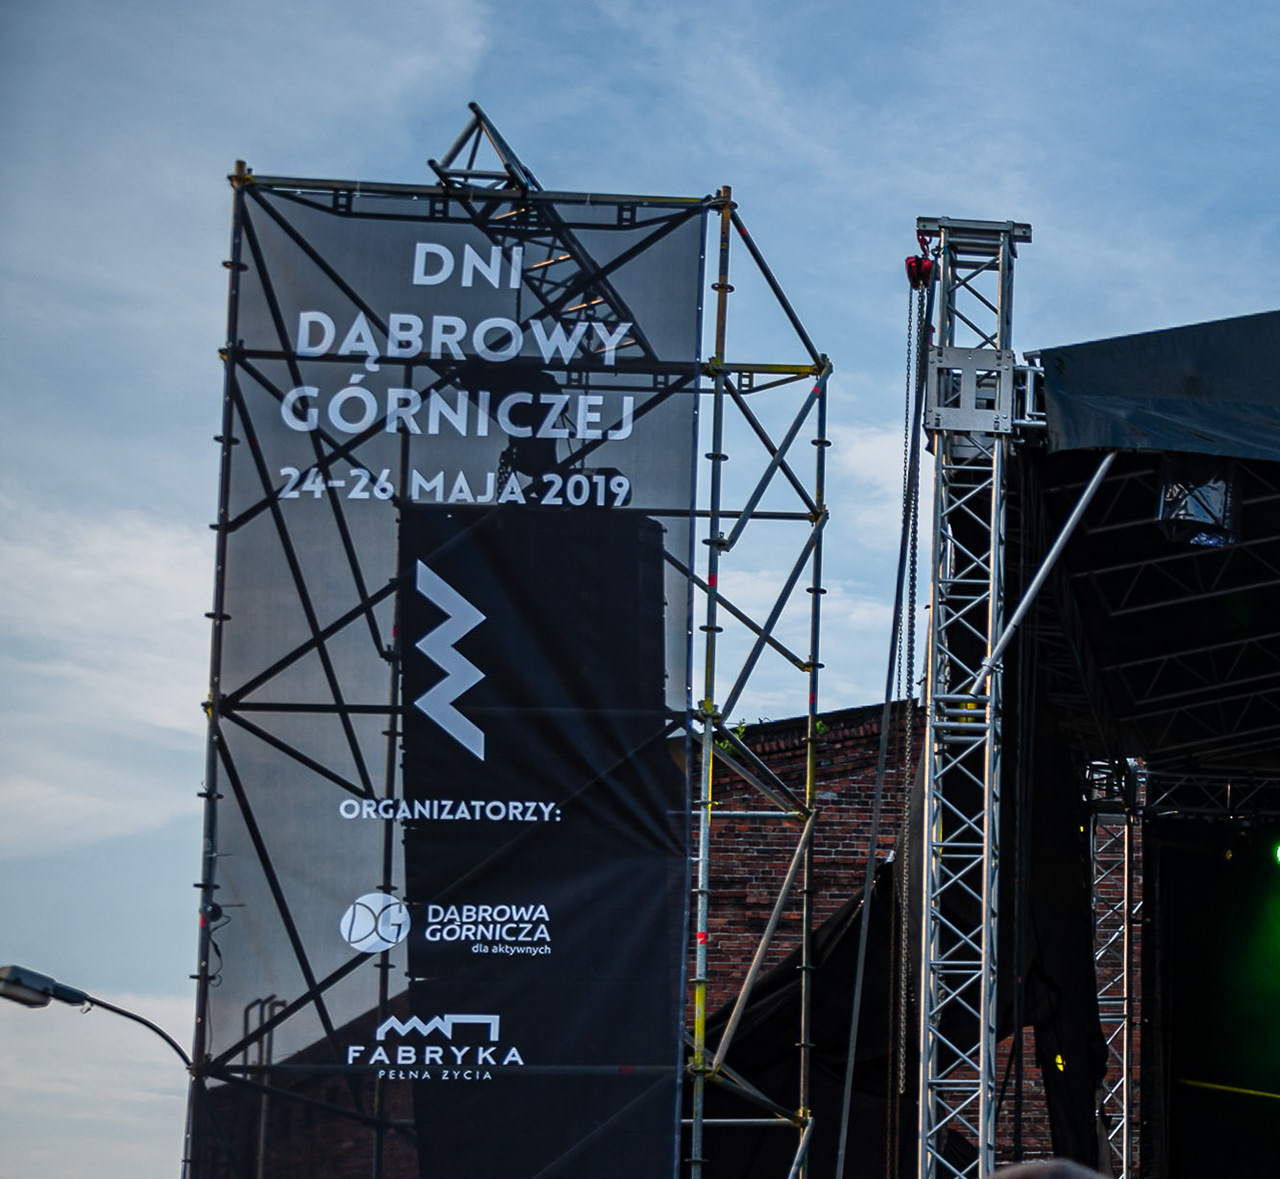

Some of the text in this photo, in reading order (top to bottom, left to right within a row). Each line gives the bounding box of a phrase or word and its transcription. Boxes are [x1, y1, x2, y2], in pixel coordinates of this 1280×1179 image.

[412, 241, 524, 291] DNI
[296, 311, 634, 372] DĄBROWY
[279, 374, 636, 442] GÓRNICZEJ
[410, 469, 526, 506] MAJA
[540, 472, 632, 508] 2019
[338, 798, 562, 823] ORGANIZATORZY:
[471, 943, 552, 956] dla aktywnych
[347, 1045, 524, 1066] FABRYKA
[378, 1069, 431, 1080] PEŁNA
